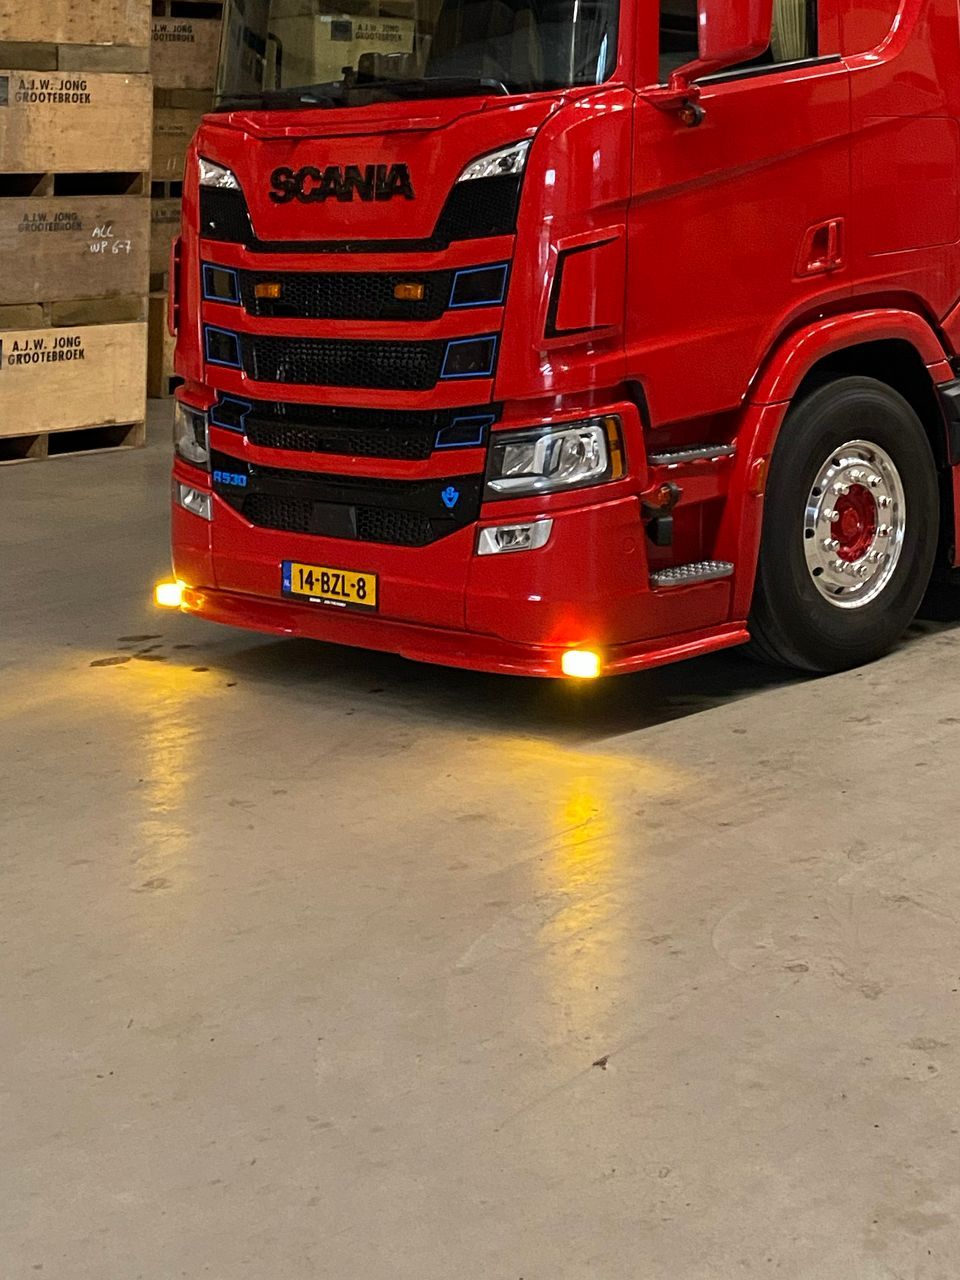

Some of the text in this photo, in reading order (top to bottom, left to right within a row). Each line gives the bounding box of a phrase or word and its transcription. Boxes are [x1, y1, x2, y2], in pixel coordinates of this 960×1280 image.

[18, 80, 87, 91] A.J.W. JONG
[15, 92, 91, 104] GROOTEBROEK
[268, 162, 415, 204] SCANIA
[54, 212, 78, 221] JONG
[17, 221, 82, 232] GROOTEBROEK
[112, 240, 131, 254] 6-7
[12, 336, 81, 352] A.J.W. JONG
[7, 348, 85, 366] GROOTEBROEK
[213, 470, 247, 488] R530
[299, 568, 367, 600] 14-BZL-8
